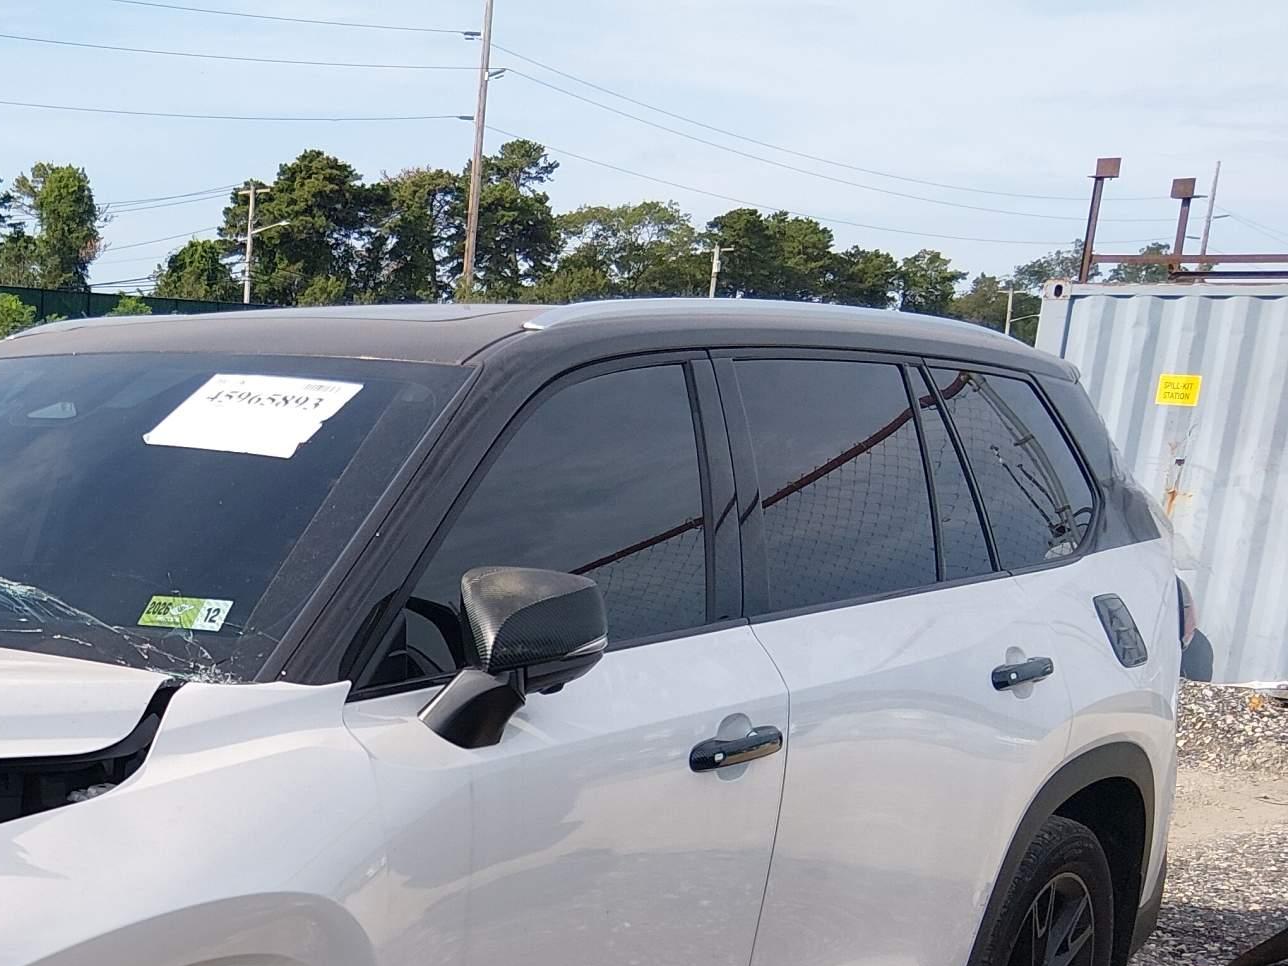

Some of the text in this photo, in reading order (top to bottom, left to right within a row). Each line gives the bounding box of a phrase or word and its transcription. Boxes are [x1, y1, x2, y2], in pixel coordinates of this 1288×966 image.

[207, 390, 324, 411] 45965893
[1162, 391, 1191, 400] STATION
[146, 601, 221, 623] 2026 12
